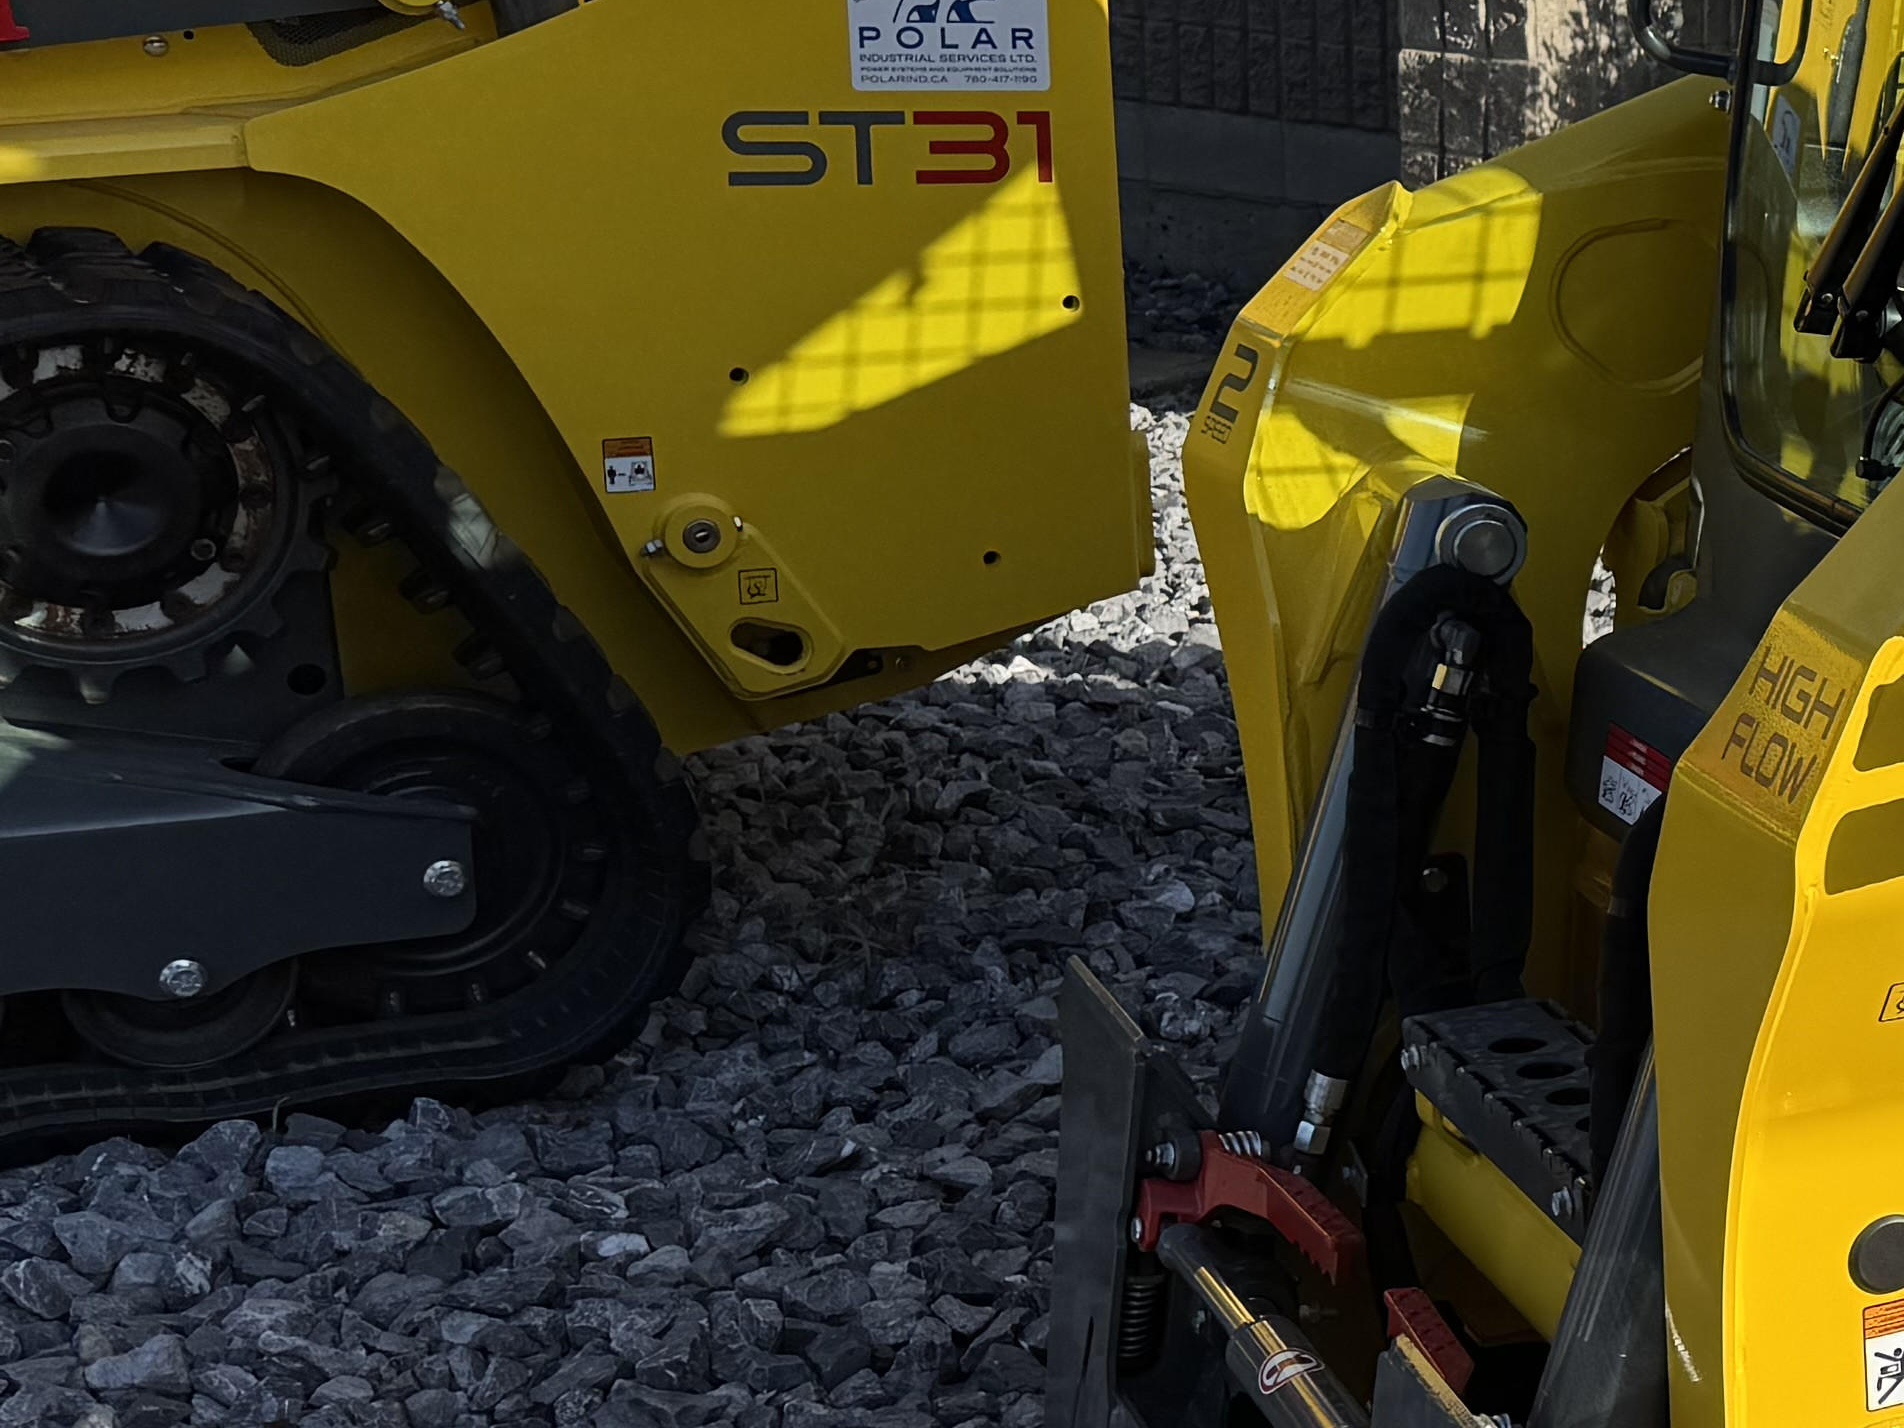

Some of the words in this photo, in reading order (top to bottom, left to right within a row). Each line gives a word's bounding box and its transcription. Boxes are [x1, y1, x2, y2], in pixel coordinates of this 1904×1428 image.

[858, 26, 1034, 50] POLAR
[860, 53, 935, 63] INDUSTRIAL
[939, 53, 1007, 63] SERVICES
[1010, 53, 1037, 63] LTD.
[861, 74, 949, 84] POLARIND.CA
[721, 110, 1053, 187] ST31
[1748, 645, 1847, 740] HIGH
[1721, 713, 1818, 804] FLOW
